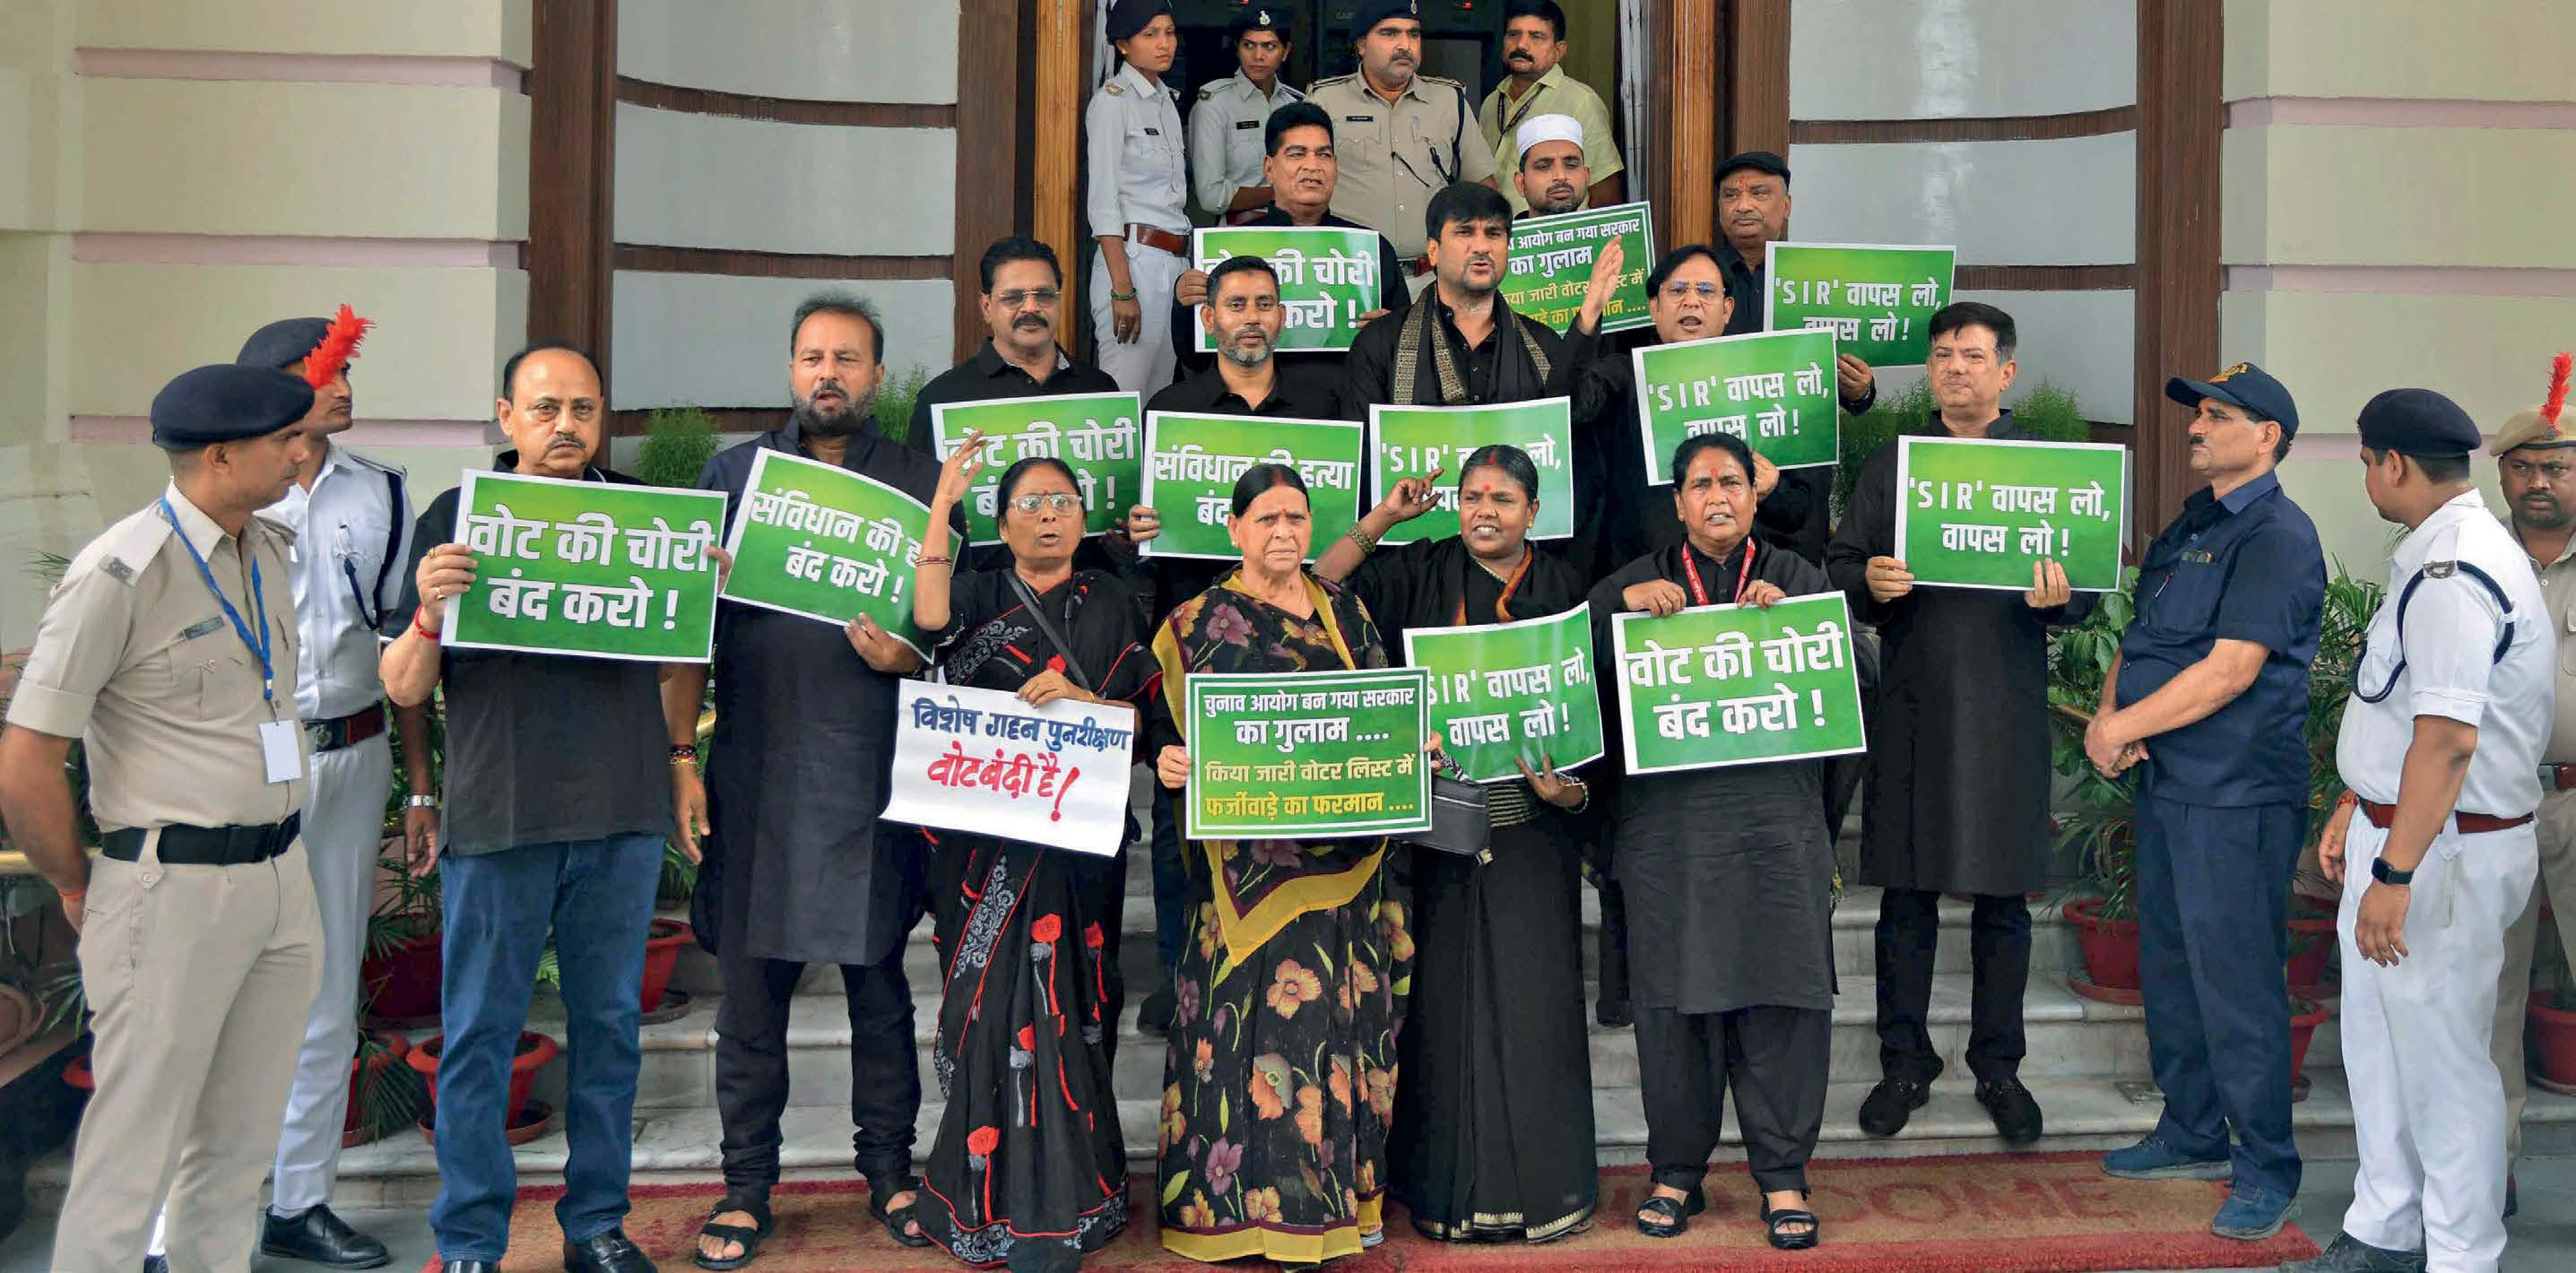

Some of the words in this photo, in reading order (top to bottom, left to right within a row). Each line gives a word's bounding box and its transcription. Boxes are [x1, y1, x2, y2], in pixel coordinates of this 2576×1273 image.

[1518, 231, 1553, 249] आयोग
[1555, 228, 1574, 244] बन
[1576, 224, 1598, 240] गया
[1600, 219, 1640, 237] सरकार
[1310, 248, 1375, 287] चोरी
[1508, 255, 1534, 275] का
[1537, 246, 1593, 278] गुलाम
[1528, 283, 1558, 302] जारी
[1631, 268, 1645, 285] में
[1845, 282, 1903, 307] वापस
[1911, 276, 1942, 310] लो,
[1869, 311, 1898, 342] लो
[1724, 372, 1785, 403] वापस
[1793, 362, 1829, 399] लो,
[1012, 420, 1062, 460] की
[1066, 417, 1136, 462] चोरी
[1756, 403, 1786, 437] लो
[1298, 459, 1355, 489] हत्या
[1990, 483, 2059, 515] वापस
[2068, 481, 2111, 522] लो,
[467, 503, 550, 560] वोट
[555, 511, 620, 567] की
[625, 516, 716, 572] चोरी
[750, 487, 864, 545] संविधान
[865, 516, 904, 559] की
[1940, 523, 2009, 553] वापस
[2018, 519, 2054, 556] लो
[785, 541, 829, 583] बंद
[829, 558, 889, 598] करो
[487, 567, 556, 621] बंद
[562, 576, 654, 629] करो
[1484, 664, 1551, 699] वापस
[1561, 646, 1591, 687] लो,
[1624, 639, 1694, 688] वोट
[1699, 630, 1755, 680] की
[1760, 620, 1844, 674] चोरी
[1203, 694, 1246, 718] चुनाव
[1251, 688, 1298, 713] आयोग
[1300, 692, 1327, 711] बन
[1330, 690, 1359, 710] गया
[1362, 688, 1415, 708] सरकार
[1653, 693, 1712, 740] बंद
[1717, 682, 1799, 735] करो
[911, 695, 983, 736] विशेष
[985, 712, 1047, 742] गहन
[1045, 716, 1132, 753] पुनरीक्षण
[1234, 719, 1270, 746] का
[1272, 717, 1350, 753] गुलाम
[1446, 713, 1511, 748] वापस
[1519, 699, 1556, 739] लो
[1205, 761, 1250, 783] किया
[1255, 759, 1297, 783] जारी
[1300, 759, 1343, 782] वोटर
[1347, 756, 1393, 780] लिस्ट
[1395, 753, 1416, 776] में
[1283, 795, 1309, 816] का
[1311, 792, 1384, 815] फरमान
